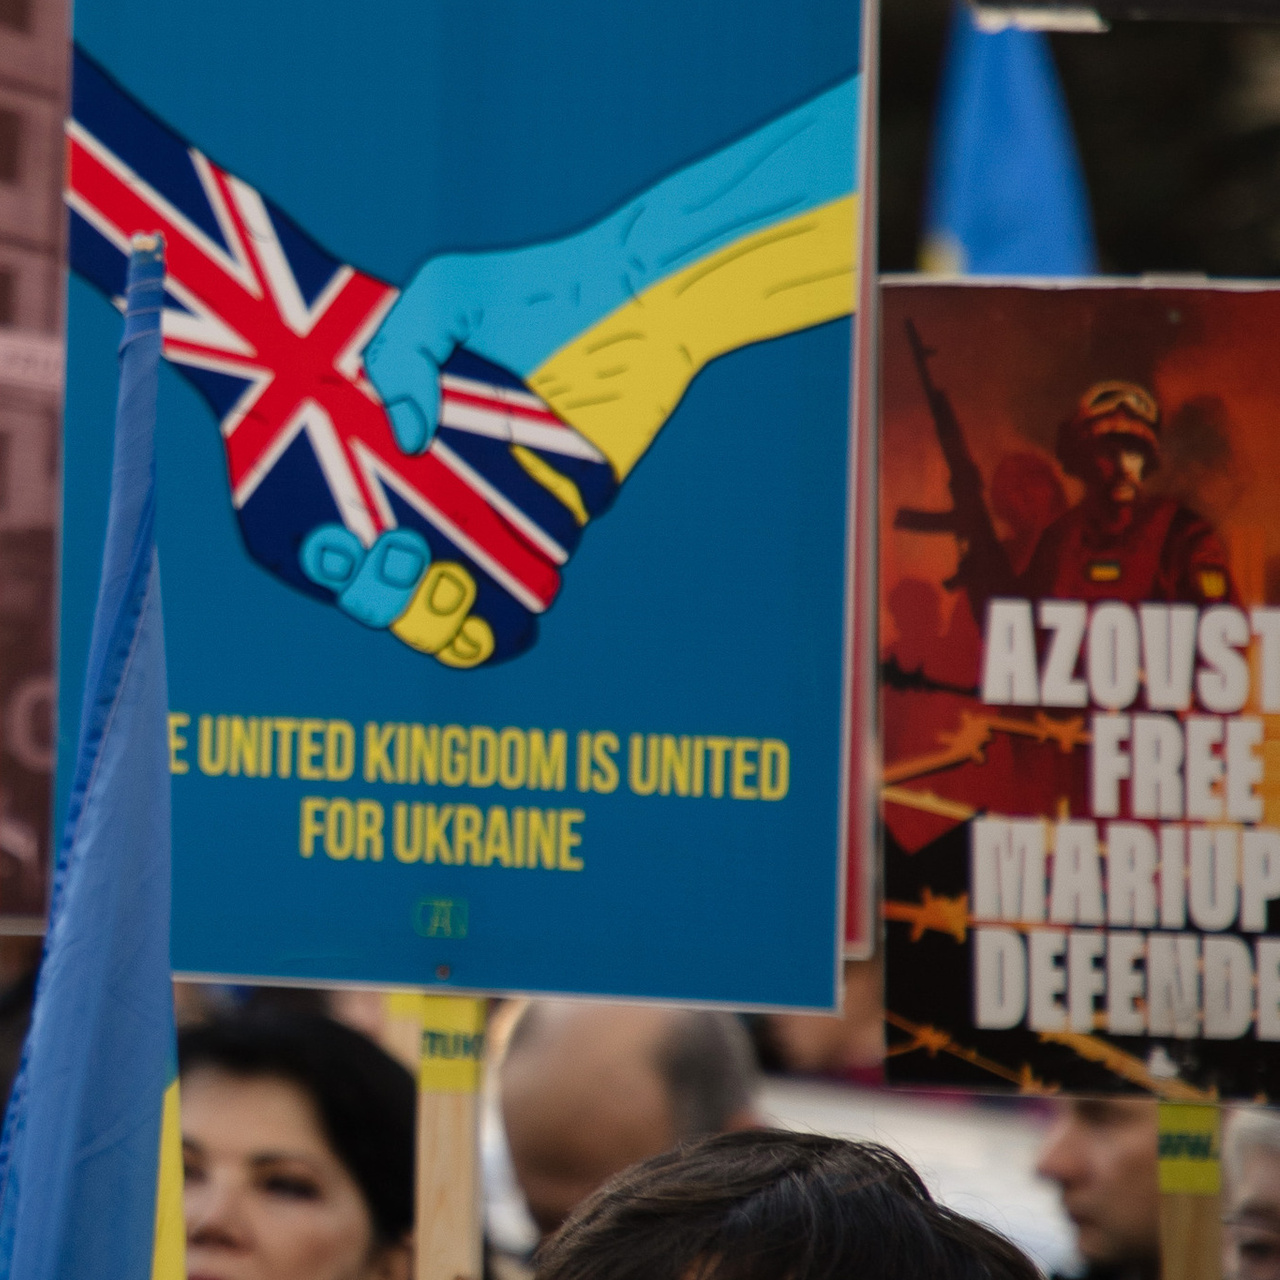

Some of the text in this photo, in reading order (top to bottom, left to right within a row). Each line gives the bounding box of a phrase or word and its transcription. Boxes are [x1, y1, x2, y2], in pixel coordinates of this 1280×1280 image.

[979, 597, 1280, 714] AZOVST
[198, 714, 355, 782] UNITED
[363, 722, 568, 793] KINGDOM
[577, 731, 619, 796] IS
[628, 732, 791, 802] UNITED
[1089, 711, 1265, 822] FREE
[300, 797, 586, 872] FOR UKRAINE
[972, 820, 1280, 934] MARIUP
